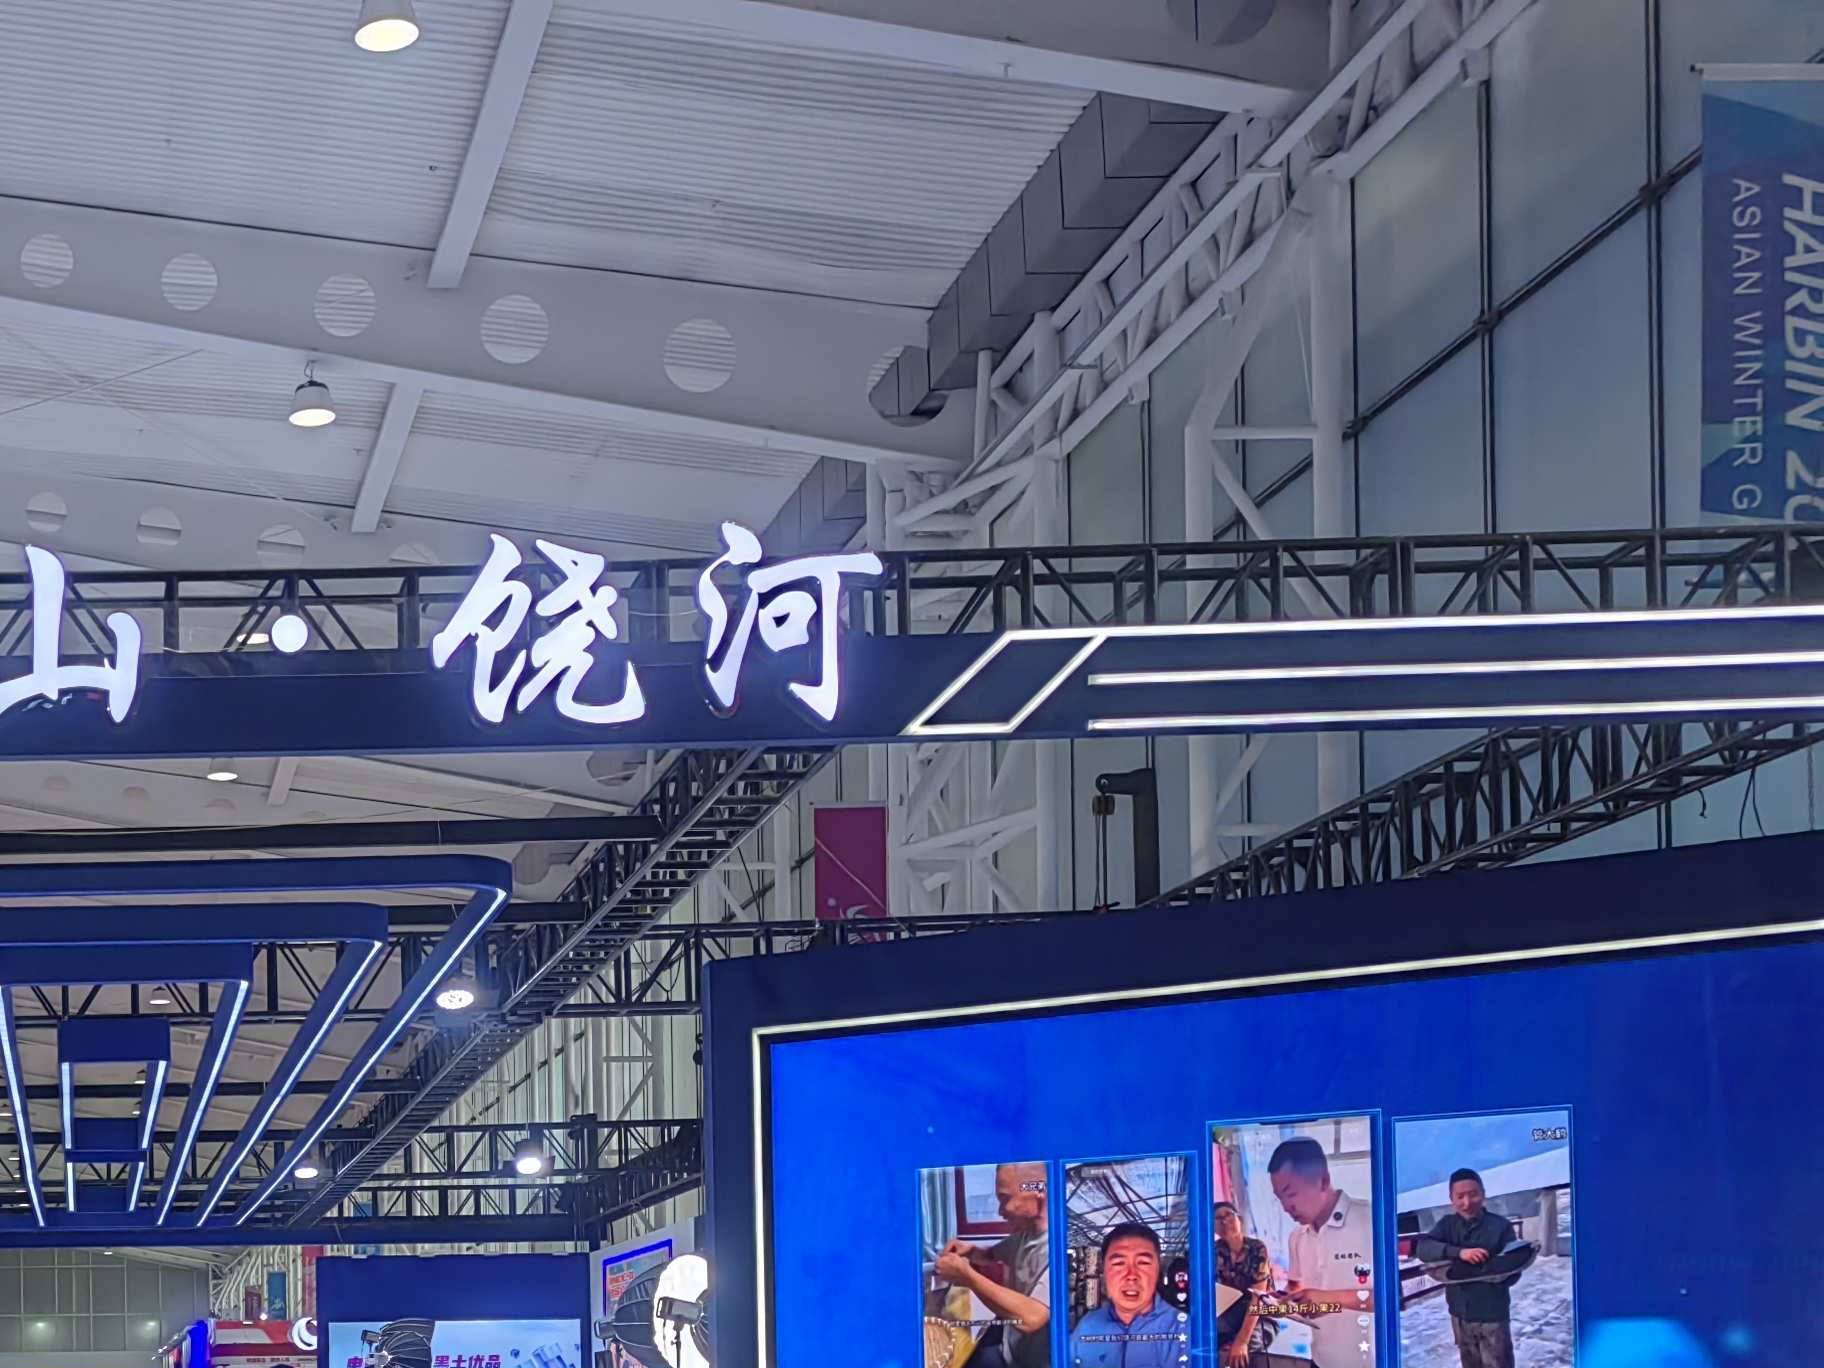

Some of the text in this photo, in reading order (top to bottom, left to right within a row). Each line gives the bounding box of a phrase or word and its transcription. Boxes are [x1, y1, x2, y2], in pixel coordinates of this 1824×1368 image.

[1732, 178, 1762, 294] ASIAN
[1781, 173, 1824, 432] HARBIN
[1732, 311, 1764, 466] WINTER
